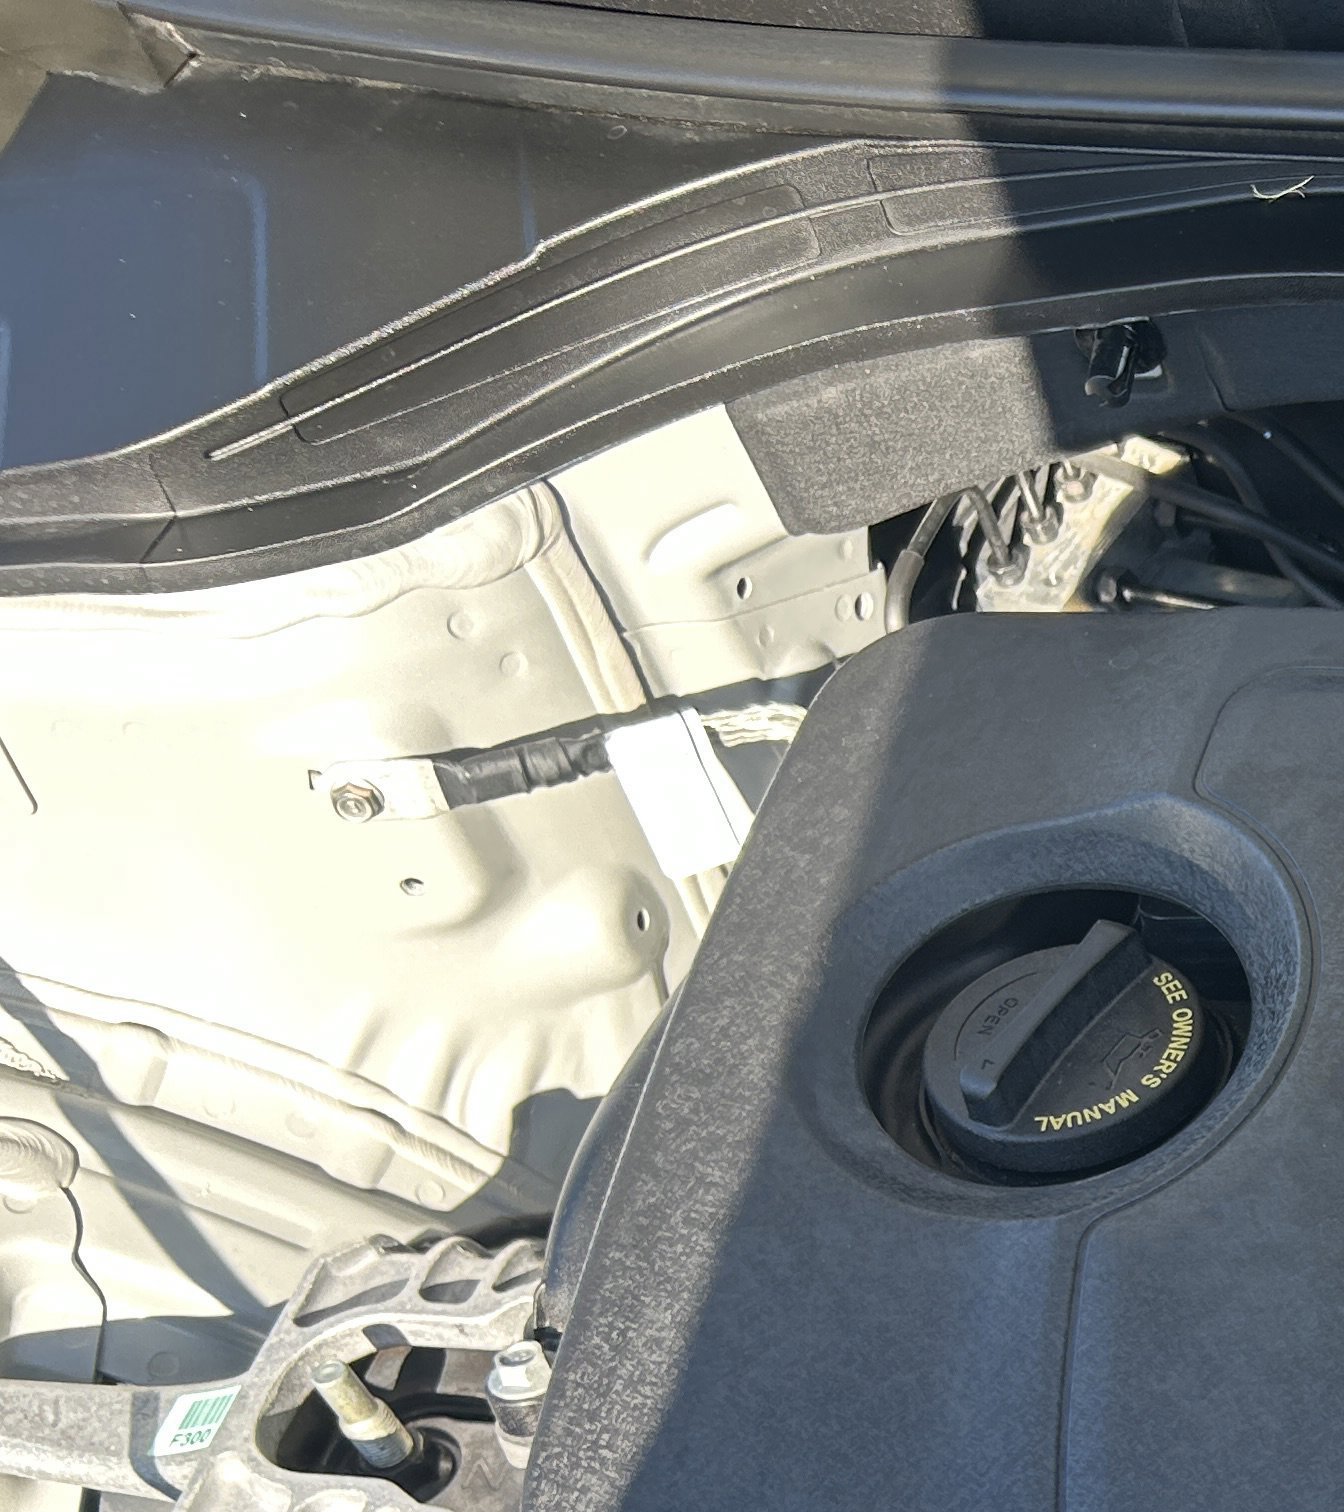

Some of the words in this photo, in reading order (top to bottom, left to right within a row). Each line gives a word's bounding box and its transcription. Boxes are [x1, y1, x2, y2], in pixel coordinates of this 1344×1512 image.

[1153, 971, 1189, 1005] SEE
[1141, 1007, 1194, 1089] OWNER'S
[1034, 1088, 1140, 1133] MANUAL
[168, 1428, 212, 1449] F300
